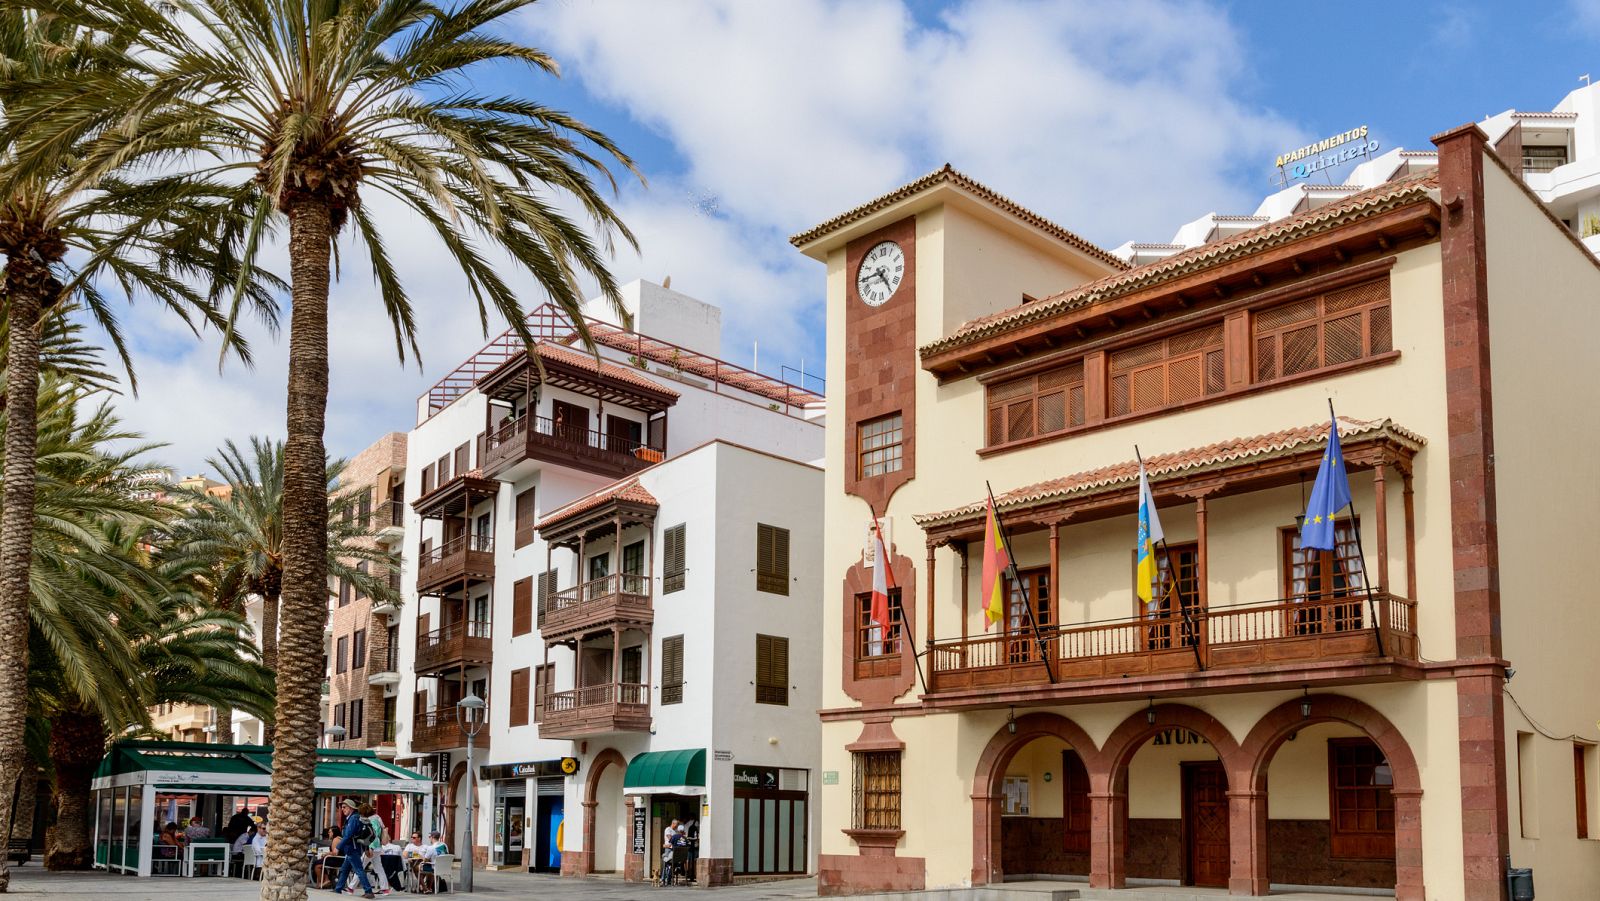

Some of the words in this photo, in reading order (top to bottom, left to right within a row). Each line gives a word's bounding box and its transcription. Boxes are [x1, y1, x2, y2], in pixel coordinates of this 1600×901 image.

[1276, 125, 1368, 168] APARTAMENTOS
[1292, 140, 1379, 178] Quintero
[1152, 728, 1208, 745] AYUN
